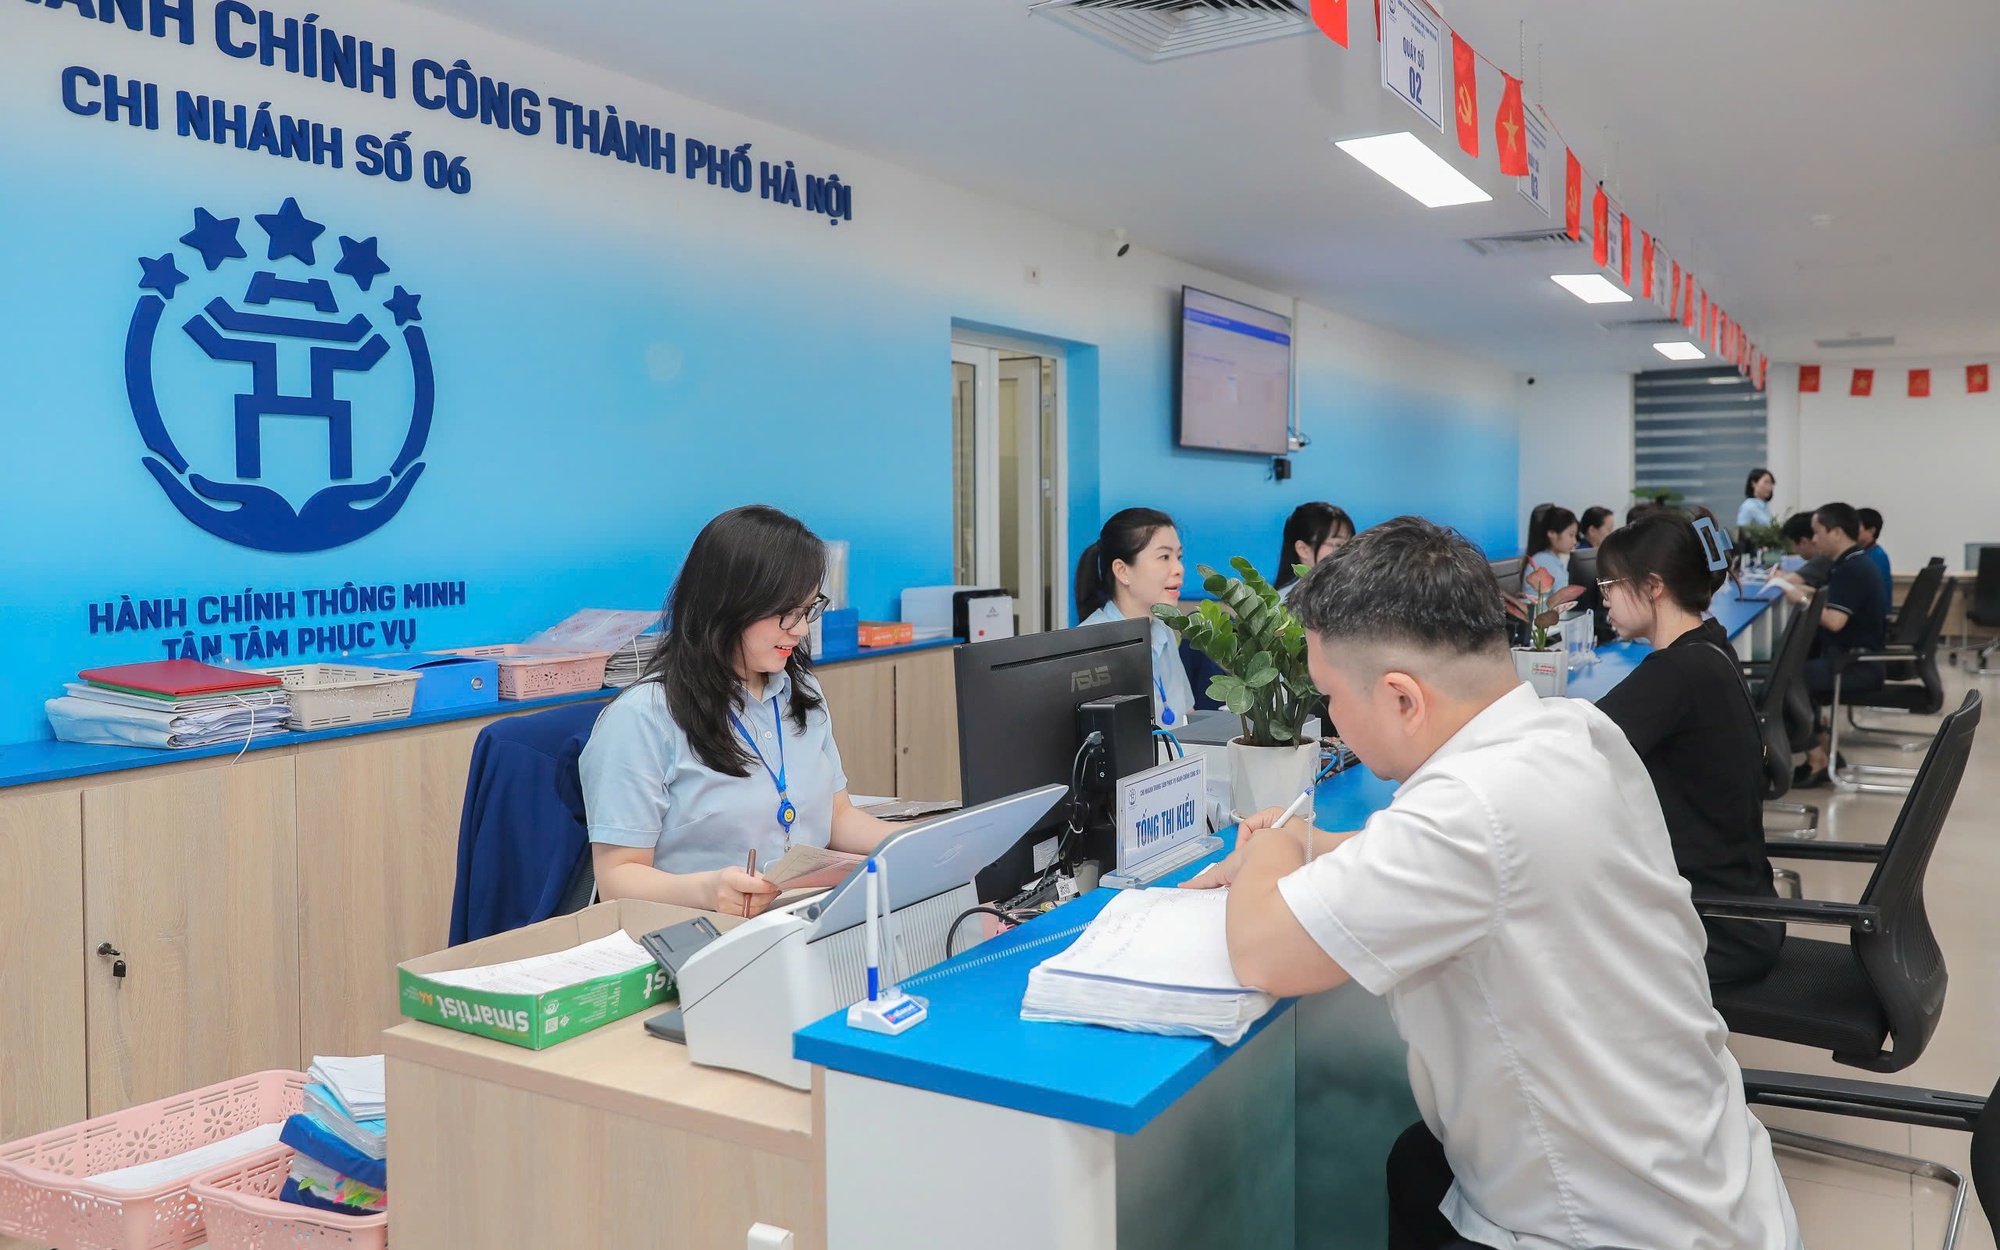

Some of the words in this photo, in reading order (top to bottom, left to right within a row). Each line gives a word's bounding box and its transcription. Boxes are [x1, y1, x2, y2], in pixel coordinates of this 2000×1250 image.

[1408, 66, 1423, 105] 02
[61, 65, 159, 131] CHI
[176, 90, 343, 169] NHÁNH
[355, 131, 413, 182] SỐ
[423, 150, 472, 195] 06
[214, 0, 397, 99] CHÍNH
[412, 58, 541, 136] CÔNG
[548, 97, 676, 174] THÀNH
[686, 138, 752, 193] PHỐ
[760, 160, 802, 208] HÀ
[806, 173, 852, 226] NỘI
[88, 594, 187, 634] HÀNH
[197, 587, 296, 625] CHÍNH
[302, 581, 396, 617] THÔNG
[403, 580, 466, 608] MINH
[162, 629, 223, 662] TÂN
[229, 625, 289, 661] TÂM
[297, 621, 376, 652] PHỤC
[380, 618, 417, 650] VỤ
[1070, 665, 1112, 692] ASUS
[1135, 808, 1160, 848] TỐNG
[1161, 807, 1175, 839] THỊ
[436, 994, 530, 1033] smartist
